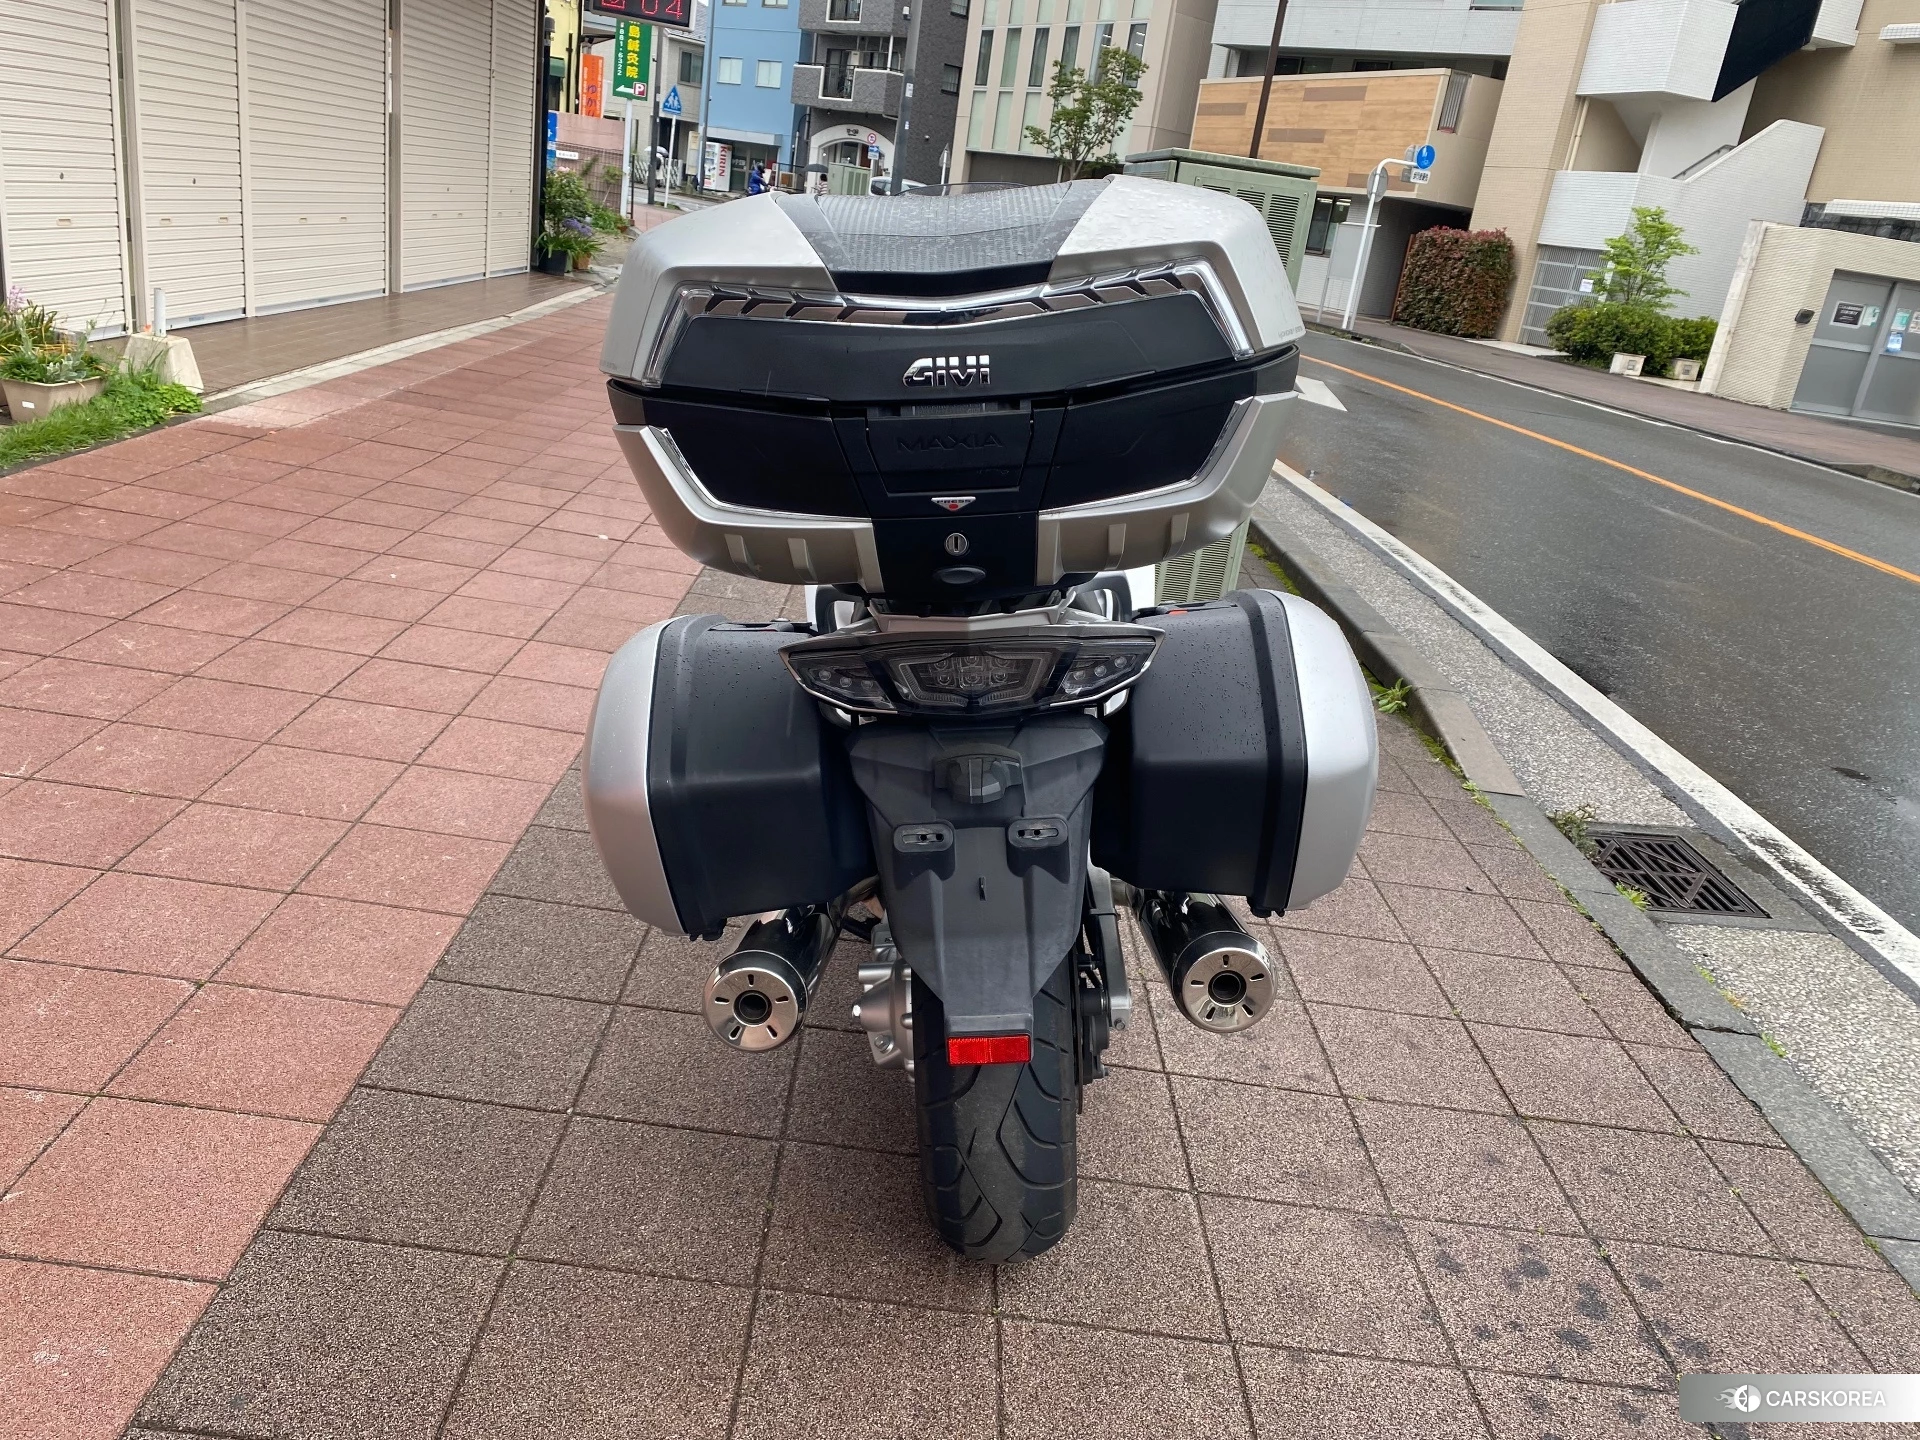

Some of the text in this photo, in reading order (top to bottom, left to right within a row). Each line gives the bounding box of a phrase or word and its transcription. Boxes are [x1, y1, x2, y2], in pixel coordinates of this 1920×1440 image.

[634, 83, 645, 95] P
[718, 145, 728, 177] KIRIN
[902, 354, 991, 387] GIVI
[896, 432, 1005, 453] MAXIA
